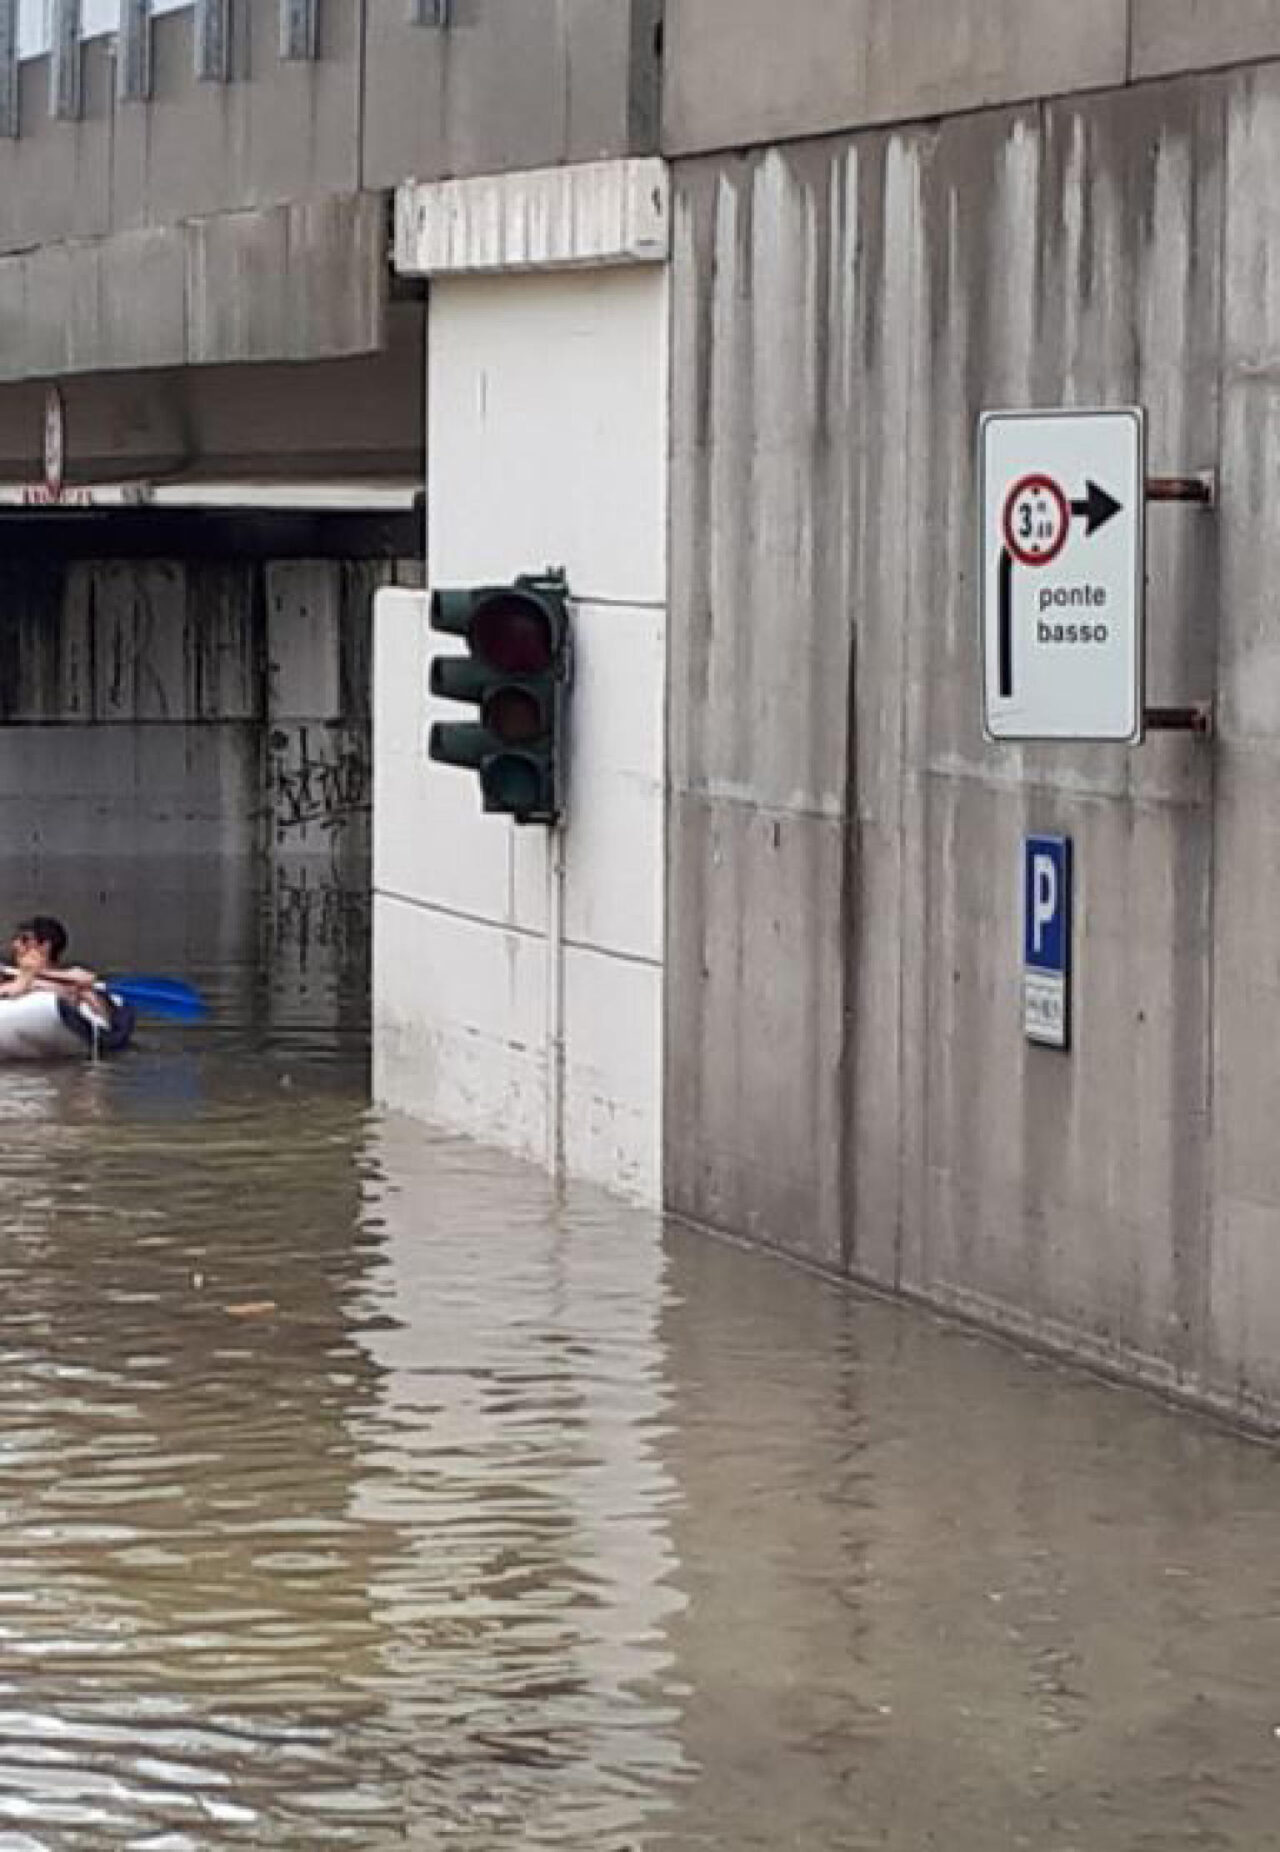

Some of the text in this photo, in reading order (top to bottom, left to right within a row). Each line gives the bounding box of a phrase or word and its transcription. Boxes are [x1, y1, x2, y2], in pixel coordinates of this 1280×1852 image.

[1039, 584, 1107, 612] ponte
[1037, 618, 1109, 644] basso
[1033, 853, 1056, 953] P
